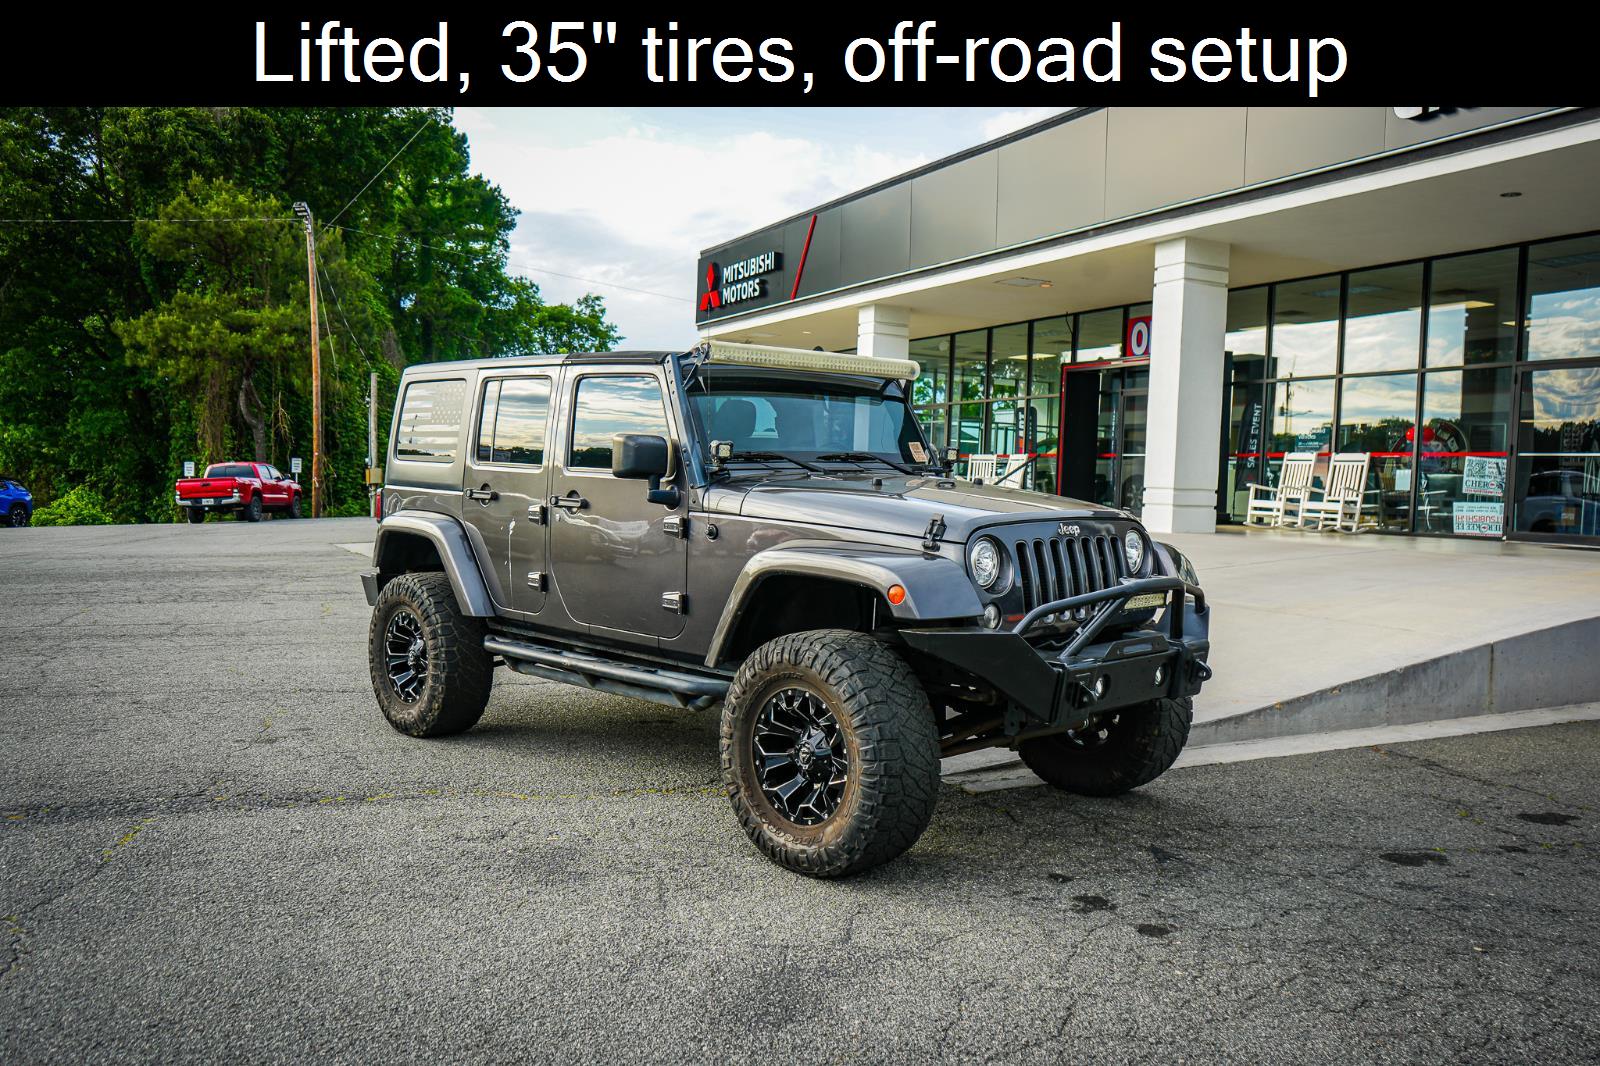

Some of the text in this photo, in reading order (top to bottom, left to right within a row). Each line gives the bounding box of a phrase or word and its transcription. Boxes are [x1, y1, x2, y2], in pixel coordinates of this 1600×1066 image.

[723, 251, 775, 284] MITSUBISHI
[723, 278, 760, 305] MOTORS
[1247, 403, 1263, 468] SALES EVENT
[1058, 523, 1081, 537] Jeep
